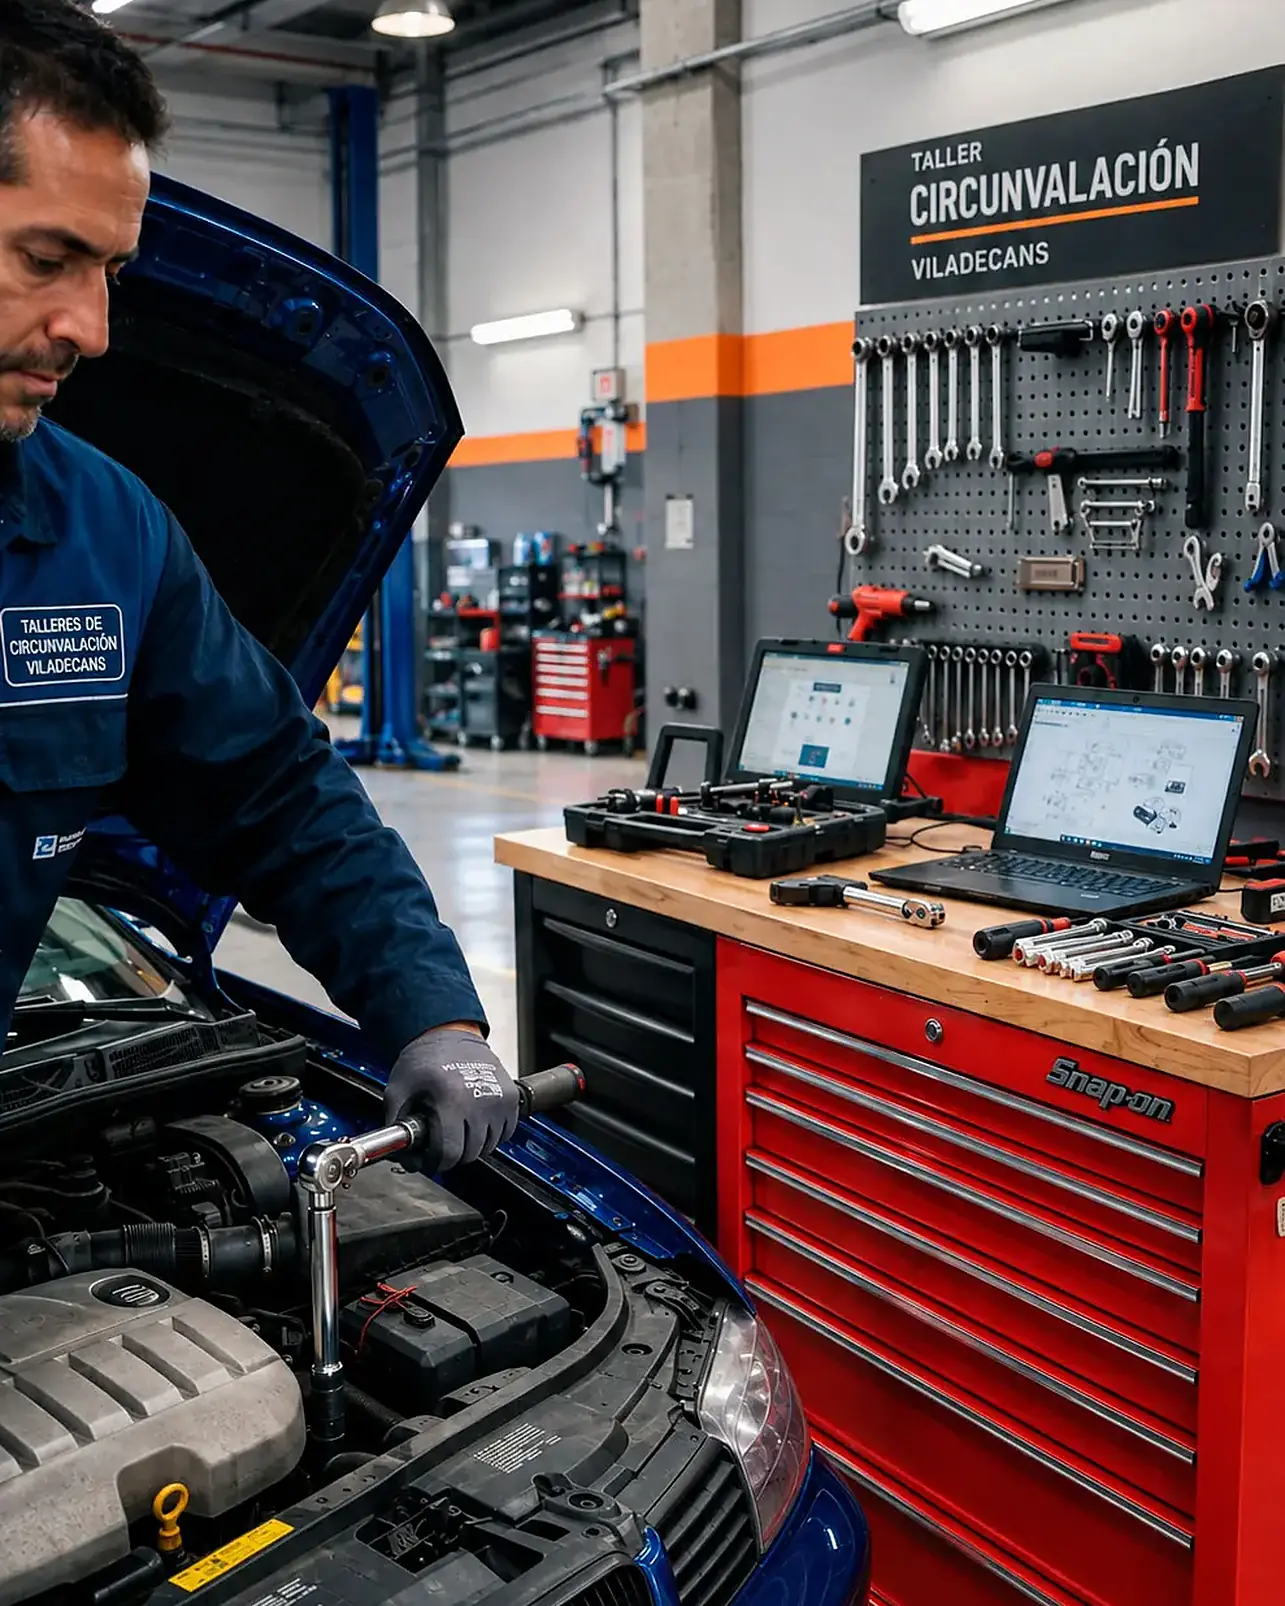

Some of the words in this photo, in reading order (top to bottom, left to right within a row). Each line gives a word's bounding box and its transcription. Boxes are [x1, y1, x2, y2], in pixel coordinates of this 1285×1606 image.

[911, 141, 982, 172] TALLER
[910, 137, 1200, 227] CIRCUNVALACIÓN
[911, 241, 1050, 281] VILADECANS
[20, 616, 82, 633] TALLERES
[85, 615, 103, 631] DE
[9, 632, 118, 656] CIRCUNVALACIÓN
[26, 656, 106, 675] VILADECANS
[1046, 1057, 1173, 1121] Snap-on
